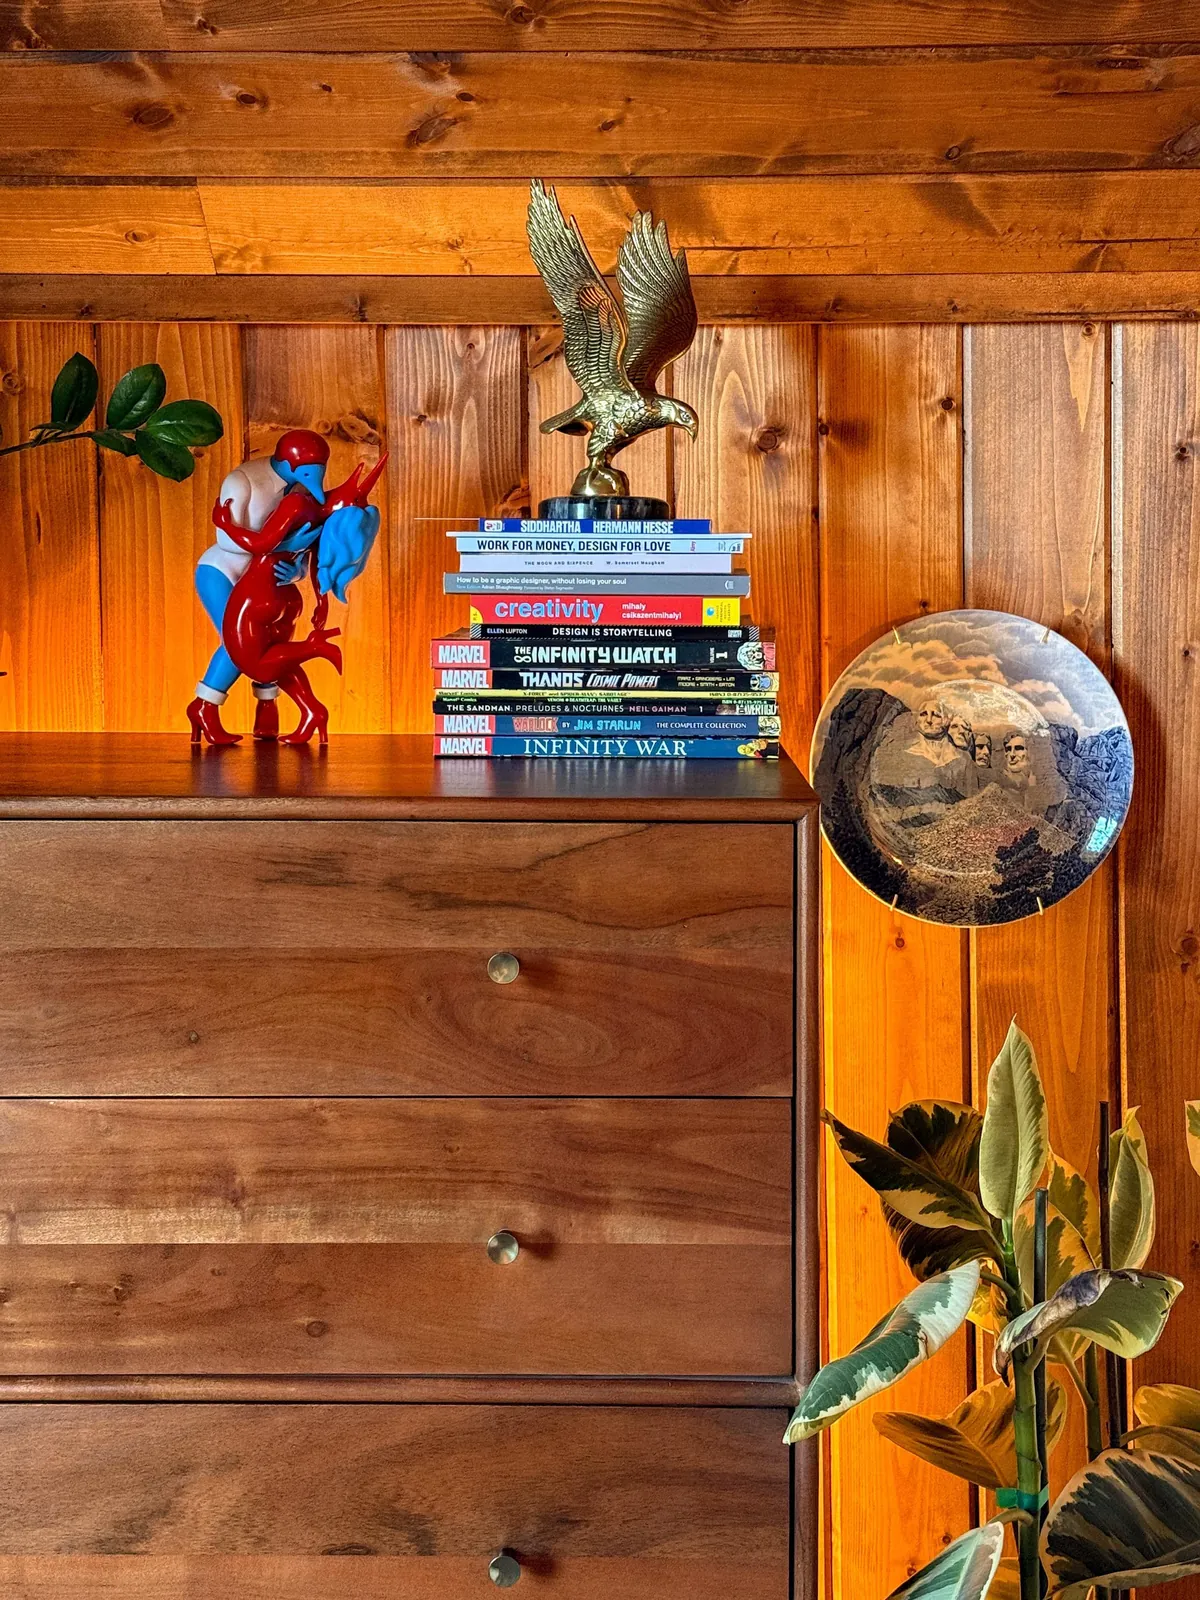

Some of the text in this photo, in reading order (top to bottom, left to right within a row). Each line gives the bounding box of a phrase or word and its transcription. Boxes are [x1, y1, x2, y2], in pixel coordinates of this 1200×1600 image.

[520, 520, 674, 534] SIDDHARTHA HERMANN HESSE
[477, 540, 671, 552] WORK FOR MONEY, DESIGN FOR LOVE
[496, 577, 520, 585] graphic
[521, 577, 550, 585] designer,
[576, 578, 596, 586] losing
[495, 598, 603, 623] creativity
[622, 602, 646, 611] mihaly
[552, 628, 672, 637] DESIGN IS STORYTELLING
[438, 645, 486, 664] MARVEL
[514, 646, 676, 664] THE INFINITY WATCH
[441, 669, 489, 688] MARVEL
[518, 672, 584, 688] THANOS
[466, 704, 513, 712] SANDMAN:
[516, 704, 561, 712] PRELUDES
[747, 704, 777, 715] VERTIGO
[443, 715, 491, 733] MARVEL
[512, 717, 558, 732] WARLOCK
[573, 719, 593, 731] JIM
[596, 719, 641, 731] STARLIN
[440, 737, 488, 755] MARVEL
[523, 739, 629, 755] INFINITY
